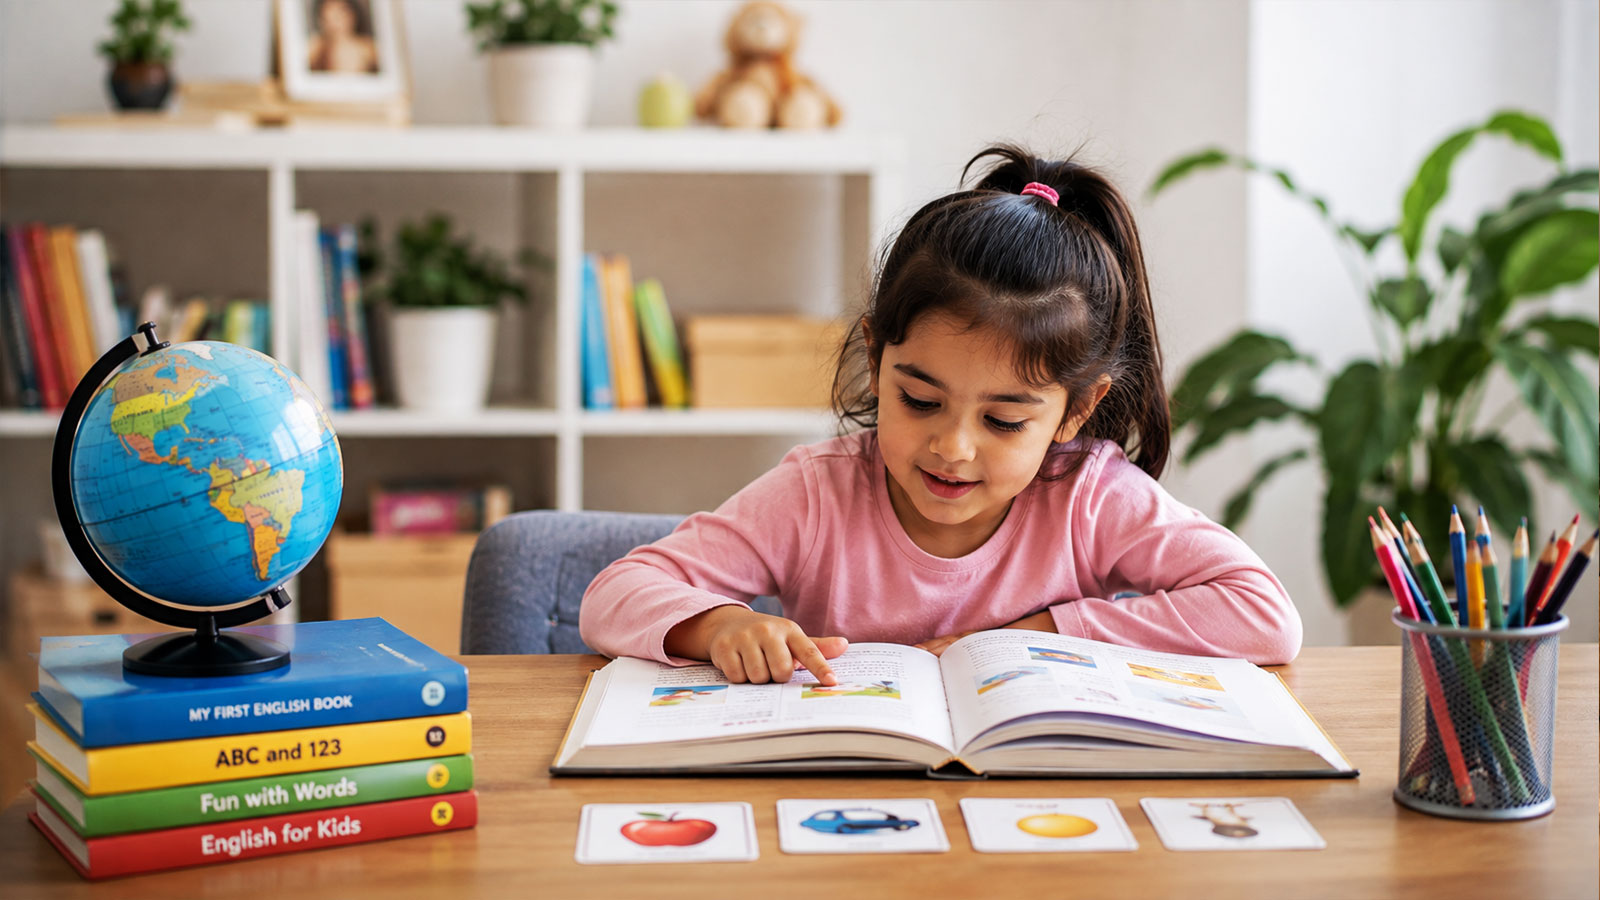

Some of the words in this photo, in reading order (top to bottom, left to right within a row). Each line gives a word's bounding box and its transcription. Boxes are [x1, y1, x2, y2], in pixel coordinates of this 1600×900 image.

[189, 707, 211, 722] MY
[214, 704, 250, 719] FIRST
[254, 698, 310, 717] ENGLISH
[314, 695, 353, 711] BOOK
[216, 746, 259, 768] ABC
[266, 742, 302, 763] and
[309, 739, 342, 757] 123
[200, 792, 240, 814] Fun
[244, 784, 289, 808] with
[293, 776, 358, 801] Words
[201, 826, 277, 857] English
[282, 823, 312, 844] for
[317, 815, 362, 839] Kids
